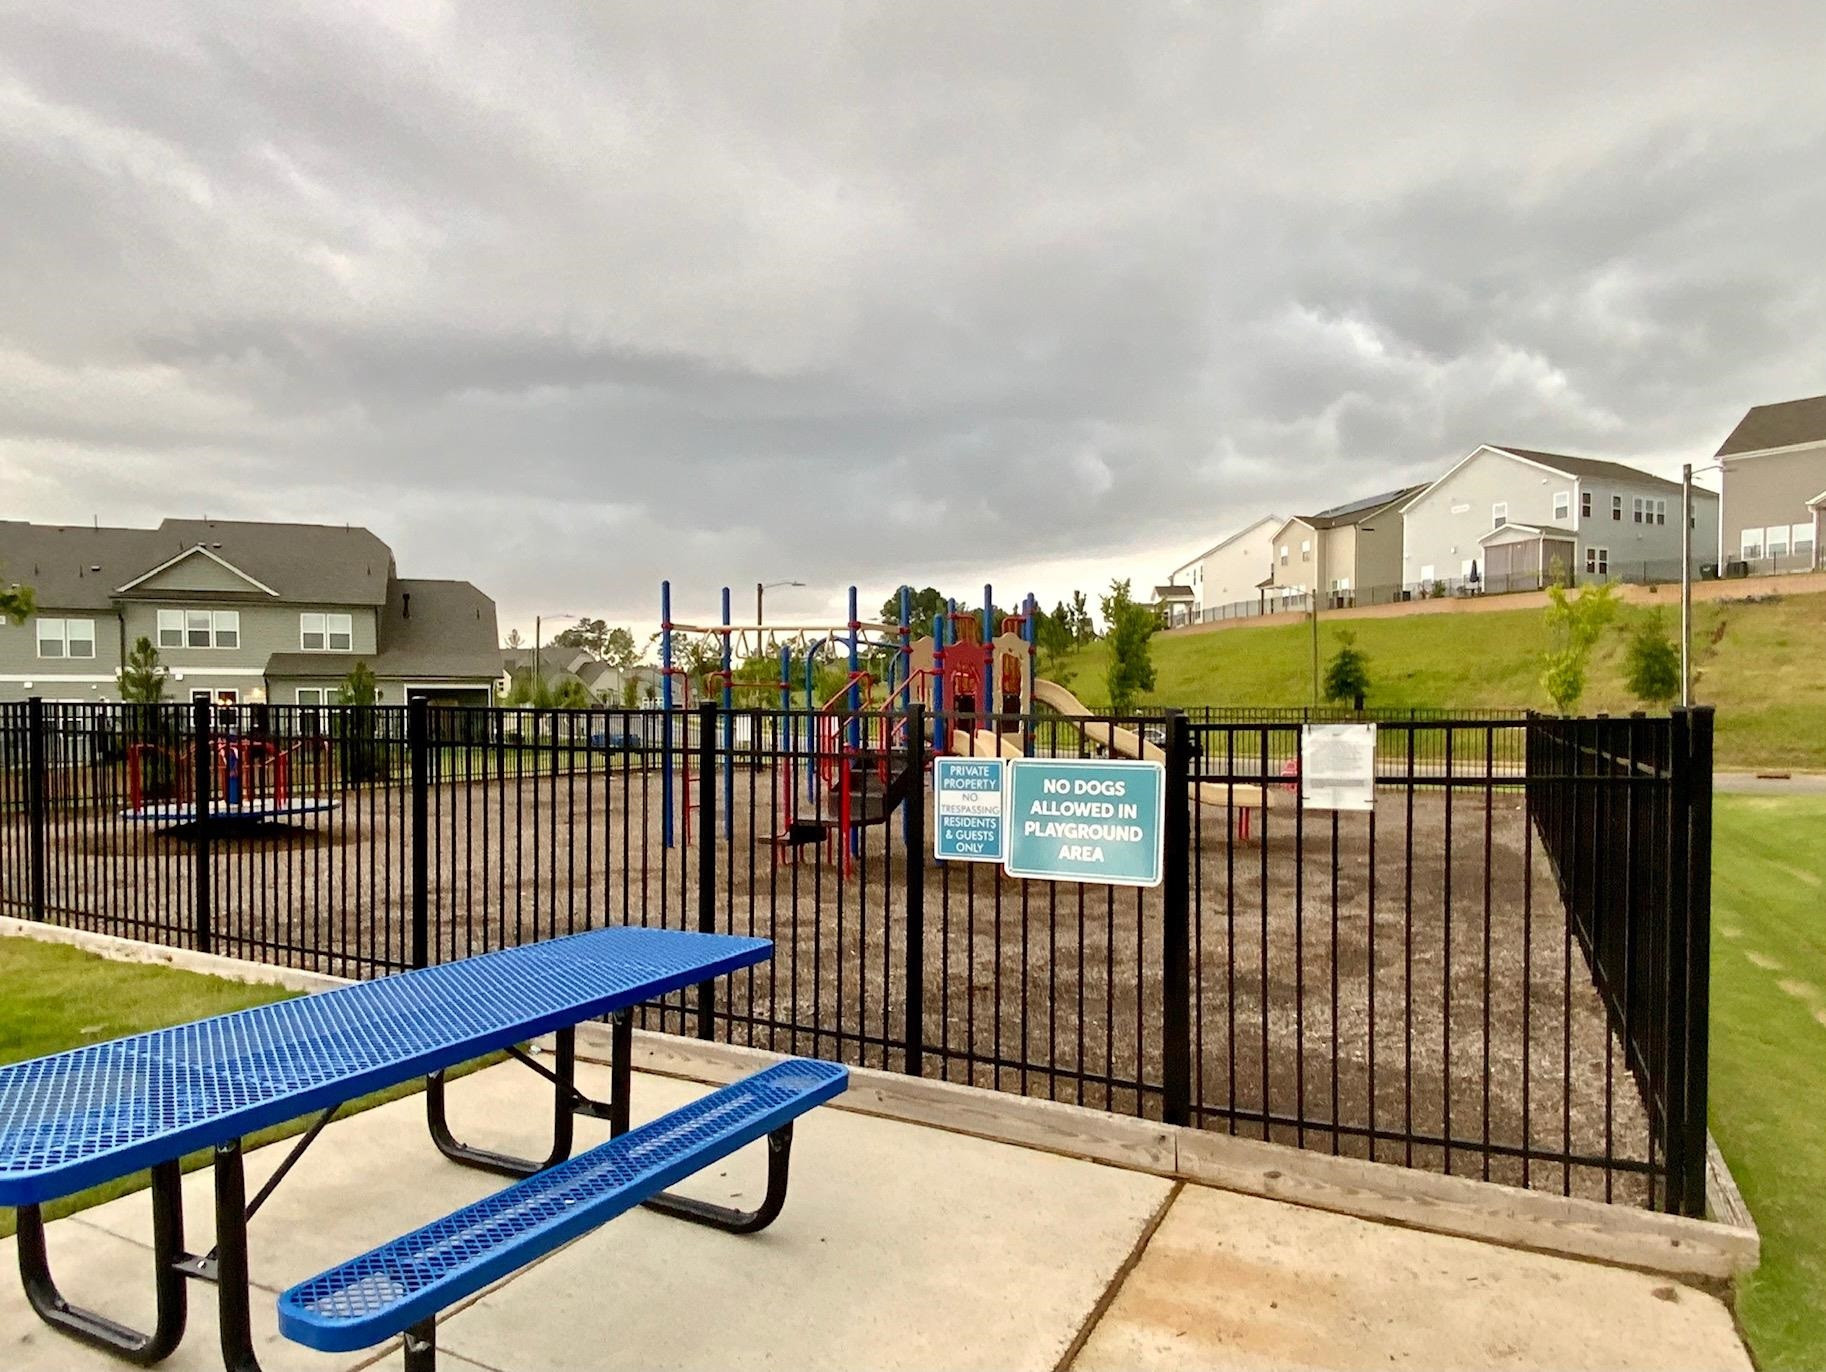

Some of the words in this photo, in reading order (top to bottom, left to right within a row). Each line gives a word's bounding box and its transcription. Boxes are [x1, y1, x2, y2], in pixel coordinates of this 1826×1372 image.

[950, 766, 990, 776] PRIVATE
[944, 778, 996, 789] PROPERTY
[1044, 779, 1072, 794] NO
[1075, 780, 1125, 796] DOGS
[962, 793, 978, 802] NO
[942, 803, 1000, 814] TRESPASSING
[1030, 800, 1114, 817] ALLOWED
[1118, 803, 1137, 819] IN
[944, 817, 996, 828] RESIDENTS
[945, 830, 953, 840] &
[956, 830, 994, 841] GUESTS
[1025, 823, 1143, 842] PLAYGROUND
[956, 843, 984, 853] ONLY
[1059, 846, 1104, 862] AREA
